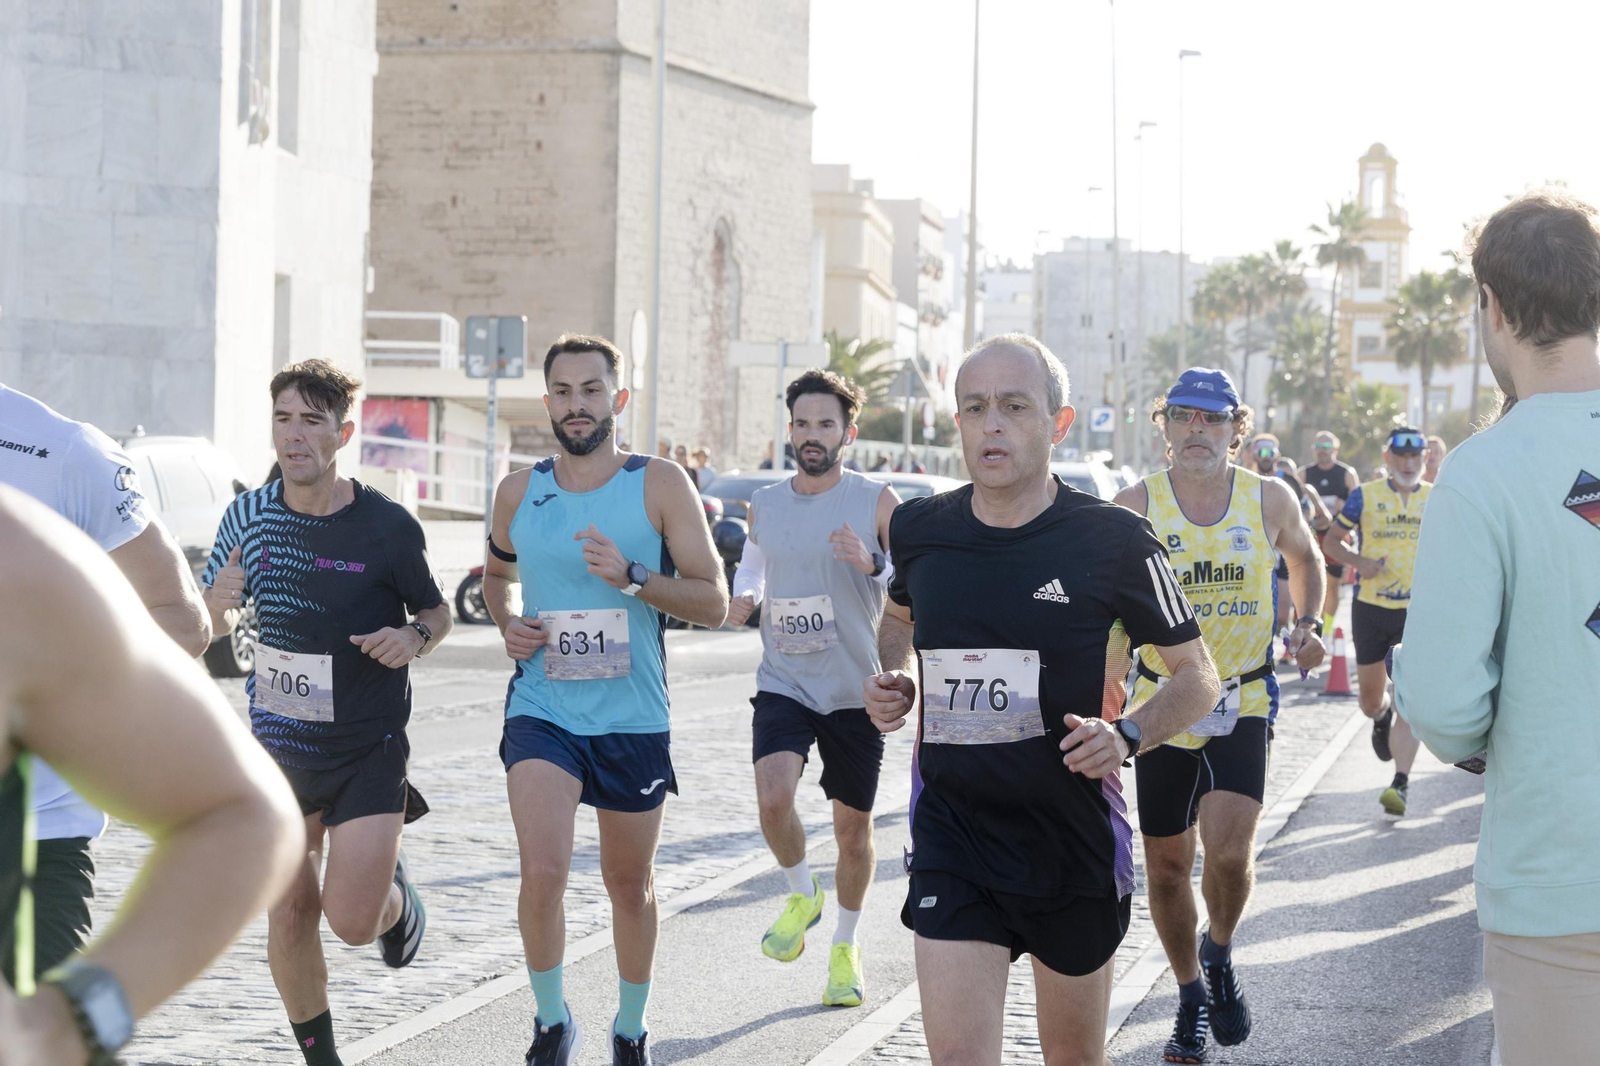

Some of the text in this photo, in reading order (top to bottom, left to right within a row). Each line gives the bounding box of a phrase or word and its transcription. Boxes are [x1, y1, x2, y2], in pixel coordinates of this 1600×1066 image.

[1032, 591, 1070, 604] adidas
[1217, 596, 1259, 617] CÁDIZ
[778, 612, 824, 635] 1590
[559, 630, 605, 656] 631
[268, 666, 310, 698] 706
[944, 678, 1009, 712] 776
[1212, 697, 1228, 717] 4
